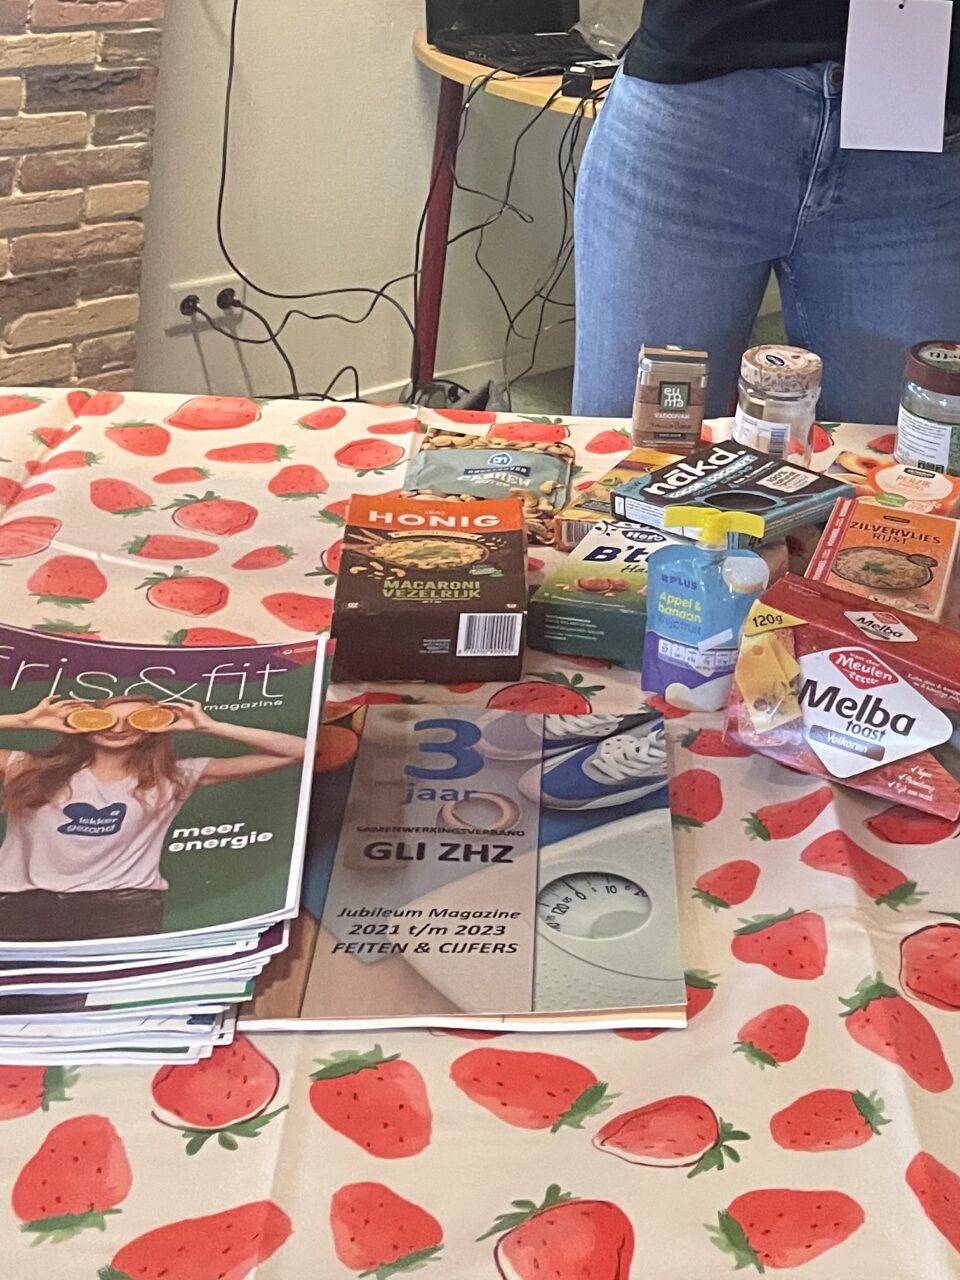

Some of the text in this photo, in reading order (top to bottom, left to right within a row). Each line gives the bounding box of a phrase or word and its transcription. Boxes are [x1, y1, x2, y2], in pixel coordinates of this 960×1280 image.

[368, 510, 500, 528] HONIG
[624, 530, 663, 544] Hero
[850, 521, 941, 544] ZILVERVLIES
[872, 532, 908, 545] RIJST
[383, 581, 480, 590] MACARONI
[669, 576, 698, 591] PLUS
[382, 589, 481, 598] VEZELRIJK
[659, 591, 692, 608] Appel
[658, 601, 702, 623] banaan
[752, 613, 784, 628] 120g
[856, 616, 904, 639] Melba
[835, 653, 893, 681] Meulen
[203, 698, 283, 712] magazine
[798, 678, 917, 737] Melba
[845, 718, 887, 742] toast
[826, 732, 869, 754] Volkoren
[402, 783, 478, 806] jaar
[66, 823, 116, 834] gezond
[171, 822, 246, 839] meer
[168, 831, 274, 853] energie
[363, 841, 515, 864] GLI ZHZ
[605, 884, 618, 895] 10
[337, 906, 521, 921] Jubileum Magazine
[348, 923, 506, 936] 2021 t/m 2023
[331, 941, 519, 955] FEITEN & CIJFERS
